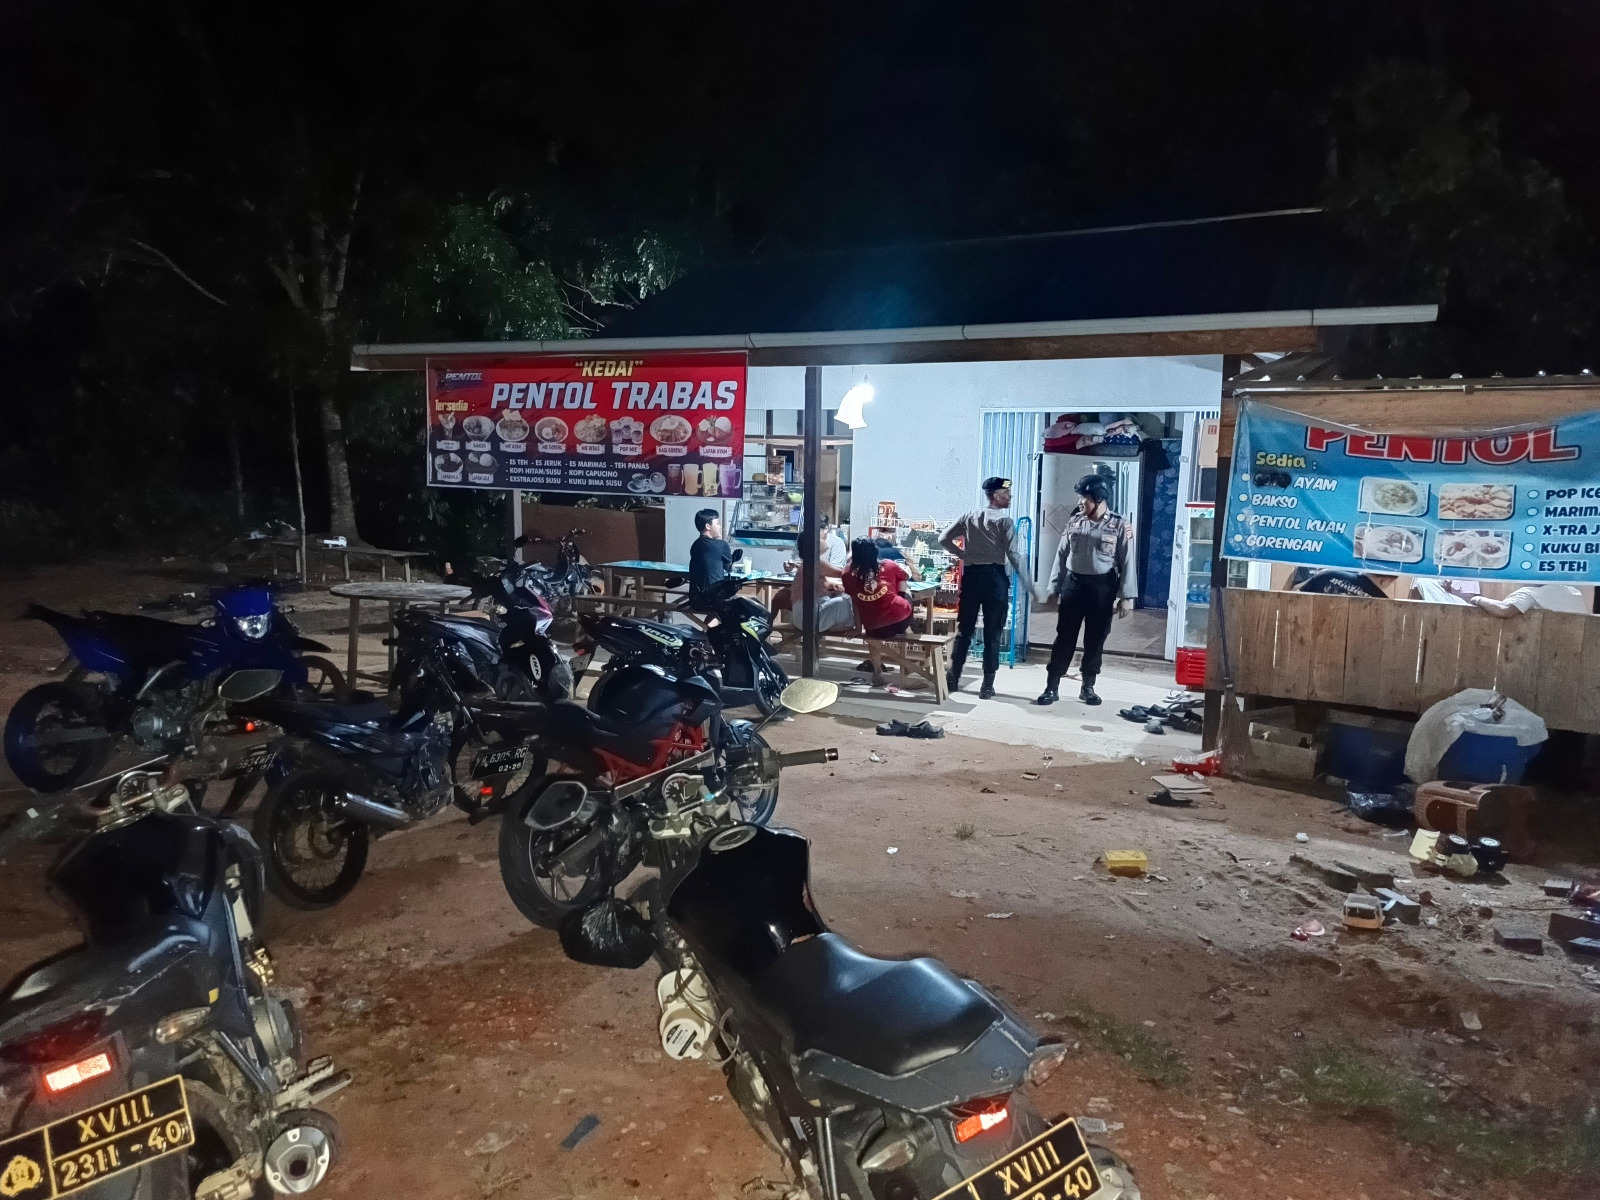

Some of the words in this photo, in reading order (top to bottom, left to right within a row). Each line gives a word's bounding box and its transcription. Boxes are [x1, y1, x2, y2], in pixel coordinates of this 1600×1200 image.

[445, 372, 483, 381] PENTOL
[490, 382, 598, 410] PENTOL
[611, 380, 738, 410] TRABAS
[435, 399, 469, 412] Tersedia
[1255, 451, 1306, 468] Sedia
[510, 476, 545, 484] EXSTRAJOSS
[586, 470, 618, 478] CAPUCINO
[1293, 476, 1338, 492] AYAM
[1251, 493, 1298, 509] BAKSO
[1546, 488, 1578, 500] POP
[1545, 506, 1600, 517] MARIM
[1249, 514, 1301, 530] PENTOL
[1306, 518, 1347, 534] KUAH
[1543, 525, 1588, 535] X-TRA
[1591, 524, 1600, 535] J
[1246, 534, 1324, 553] GORENGAN
[1541, 543, 1581, 554] KUKU
[1538, 561, 1556, 572] ES
[1559, 561, 1588, 572] TEH
[77, 1094, 153, 1143] XVIII
[60, 1144, 120, 1187] 2311
[148, 1120, 183, 1151] 40
[996, 1141, 1060, 1195] XVIII
[1064, 1166, 1093, 1198] 40
